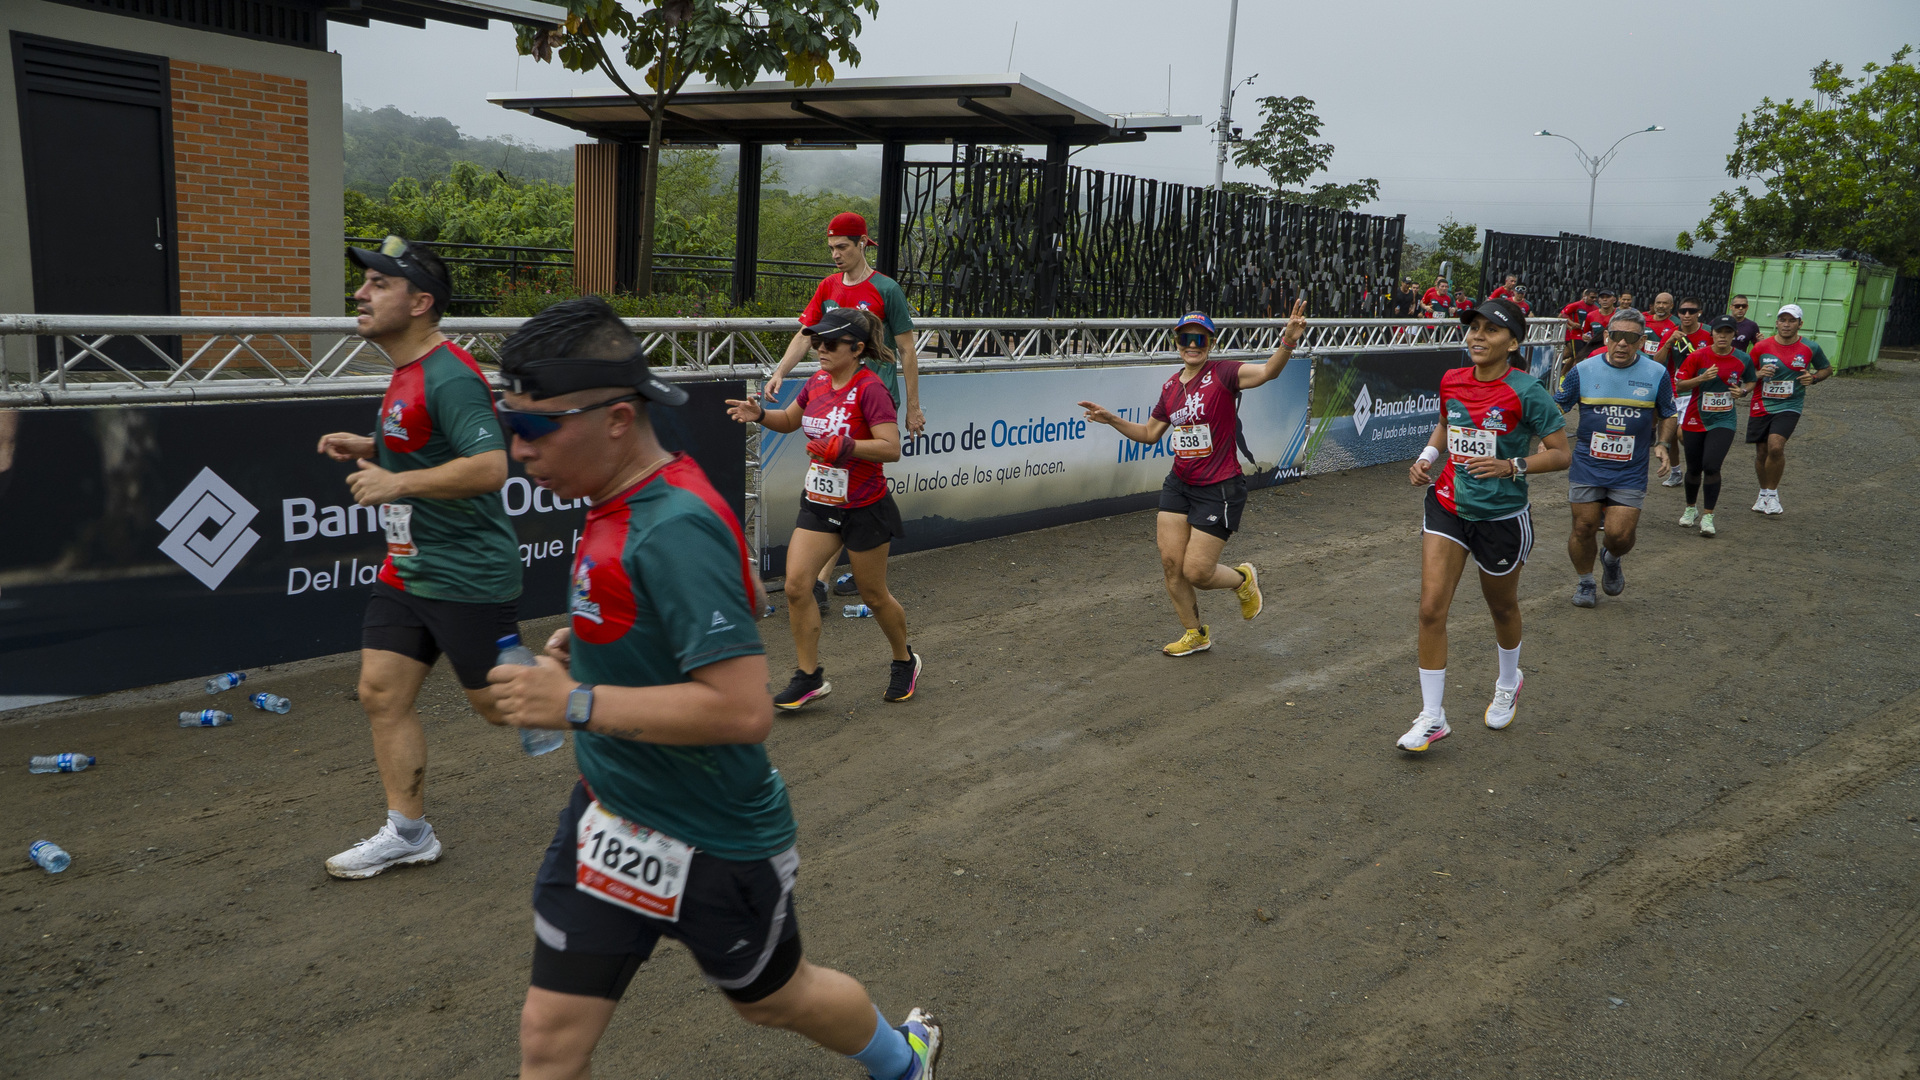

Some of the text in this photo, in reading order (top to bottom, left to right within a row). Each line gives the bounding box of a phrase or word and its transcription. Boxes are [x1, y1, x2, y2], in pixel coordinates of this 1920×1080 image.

[1374, 398, 1403, 418] Banco
[1404, 395, 1416, 414] de
[1710, 398, 1727, 406] 360
[1593, 405, 1642, 419] CARLOS
[1606, 416, 1627, 426] COL
[898, 416, 1086, 457] anco de Occidente
[1372, 427, 1384, 441] Del
[1398, 423, 1407, 437] de
[1407, 422, 1417, 436] los
[1417, 424, 1429, 437] que
[1180, 435, 1200, 448] 538
[1453, 438, 1486, 456] 1843
[1601, 442, 1623, 453] 610
[885, 459, 1066, 494] Del lado de los que hacen.
[1274, 467, 1300, 480] AVAL
[813, 476, 834, 493] 153
[286, 560, 340, 595] Del
[518, 539, 564, 568] que
[590, 829, 662, 887] 1820
